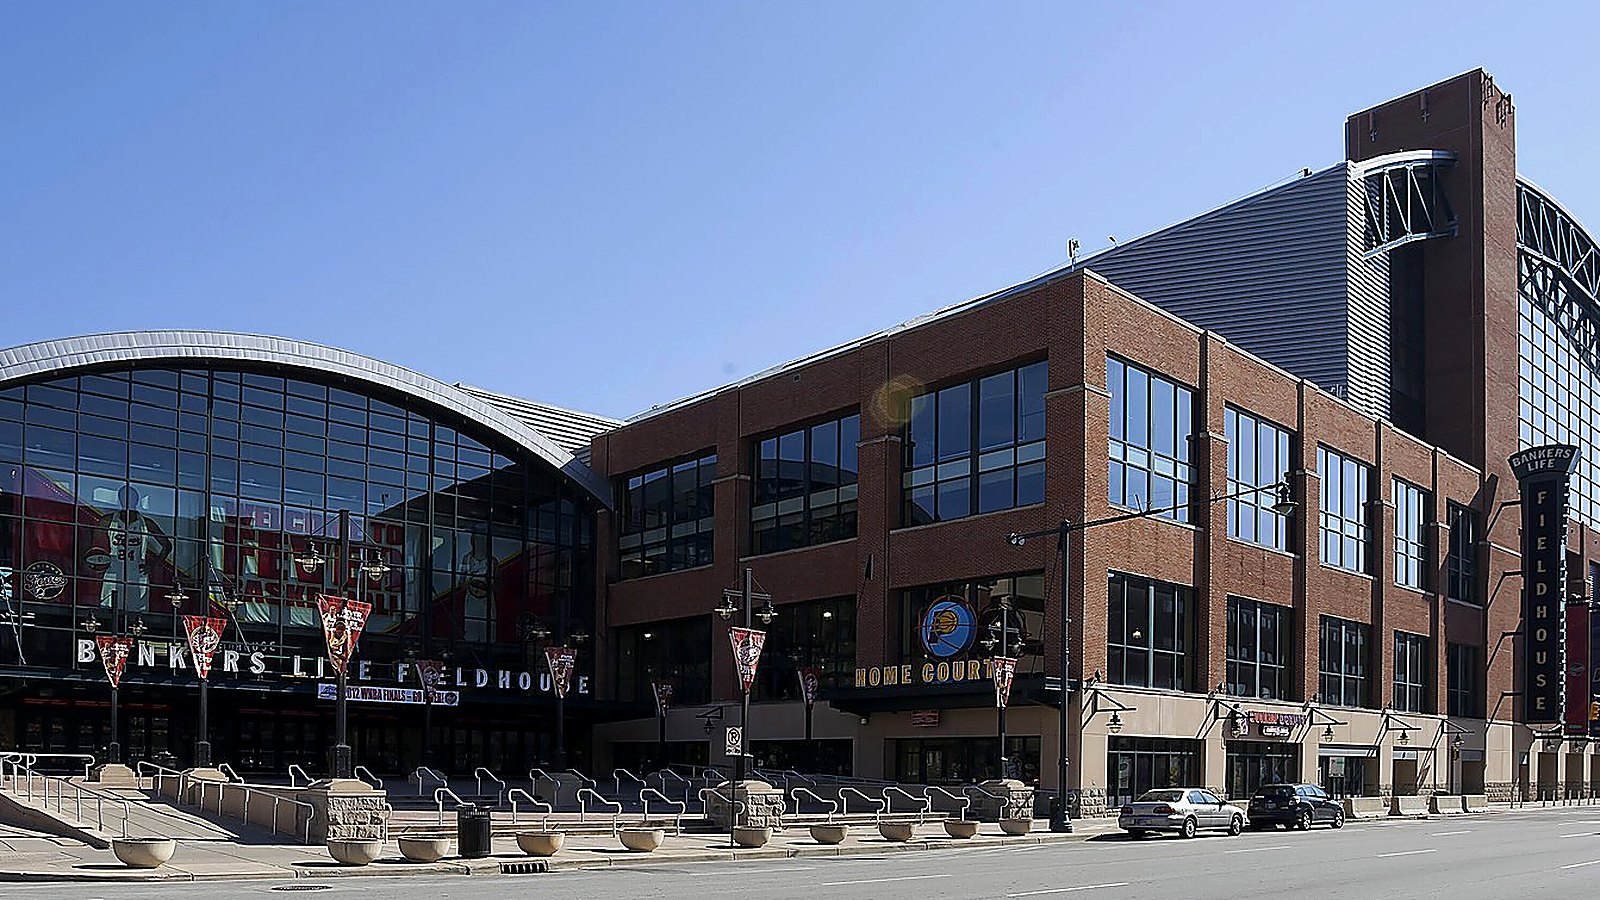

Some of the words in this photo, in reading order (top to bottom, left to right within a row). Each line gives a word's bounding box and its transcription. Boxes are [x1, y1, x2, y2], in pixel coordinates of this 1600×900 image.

[1513, 448, 1572, 468] BANKERS
[1527, 459, 1556, 472] LIFE
[1536, 491, 1547, 711] FIELDHOUSE
[78, 639, 266, 675] BNKRS
[293, 655, 372, 680] LIE
[398, 663, 589, 694] FELDHOUE
[855, 664, 912, 688] HOME
[922, 658, 994, 683] COURT
[383, 688, 406, 702] FINALS
